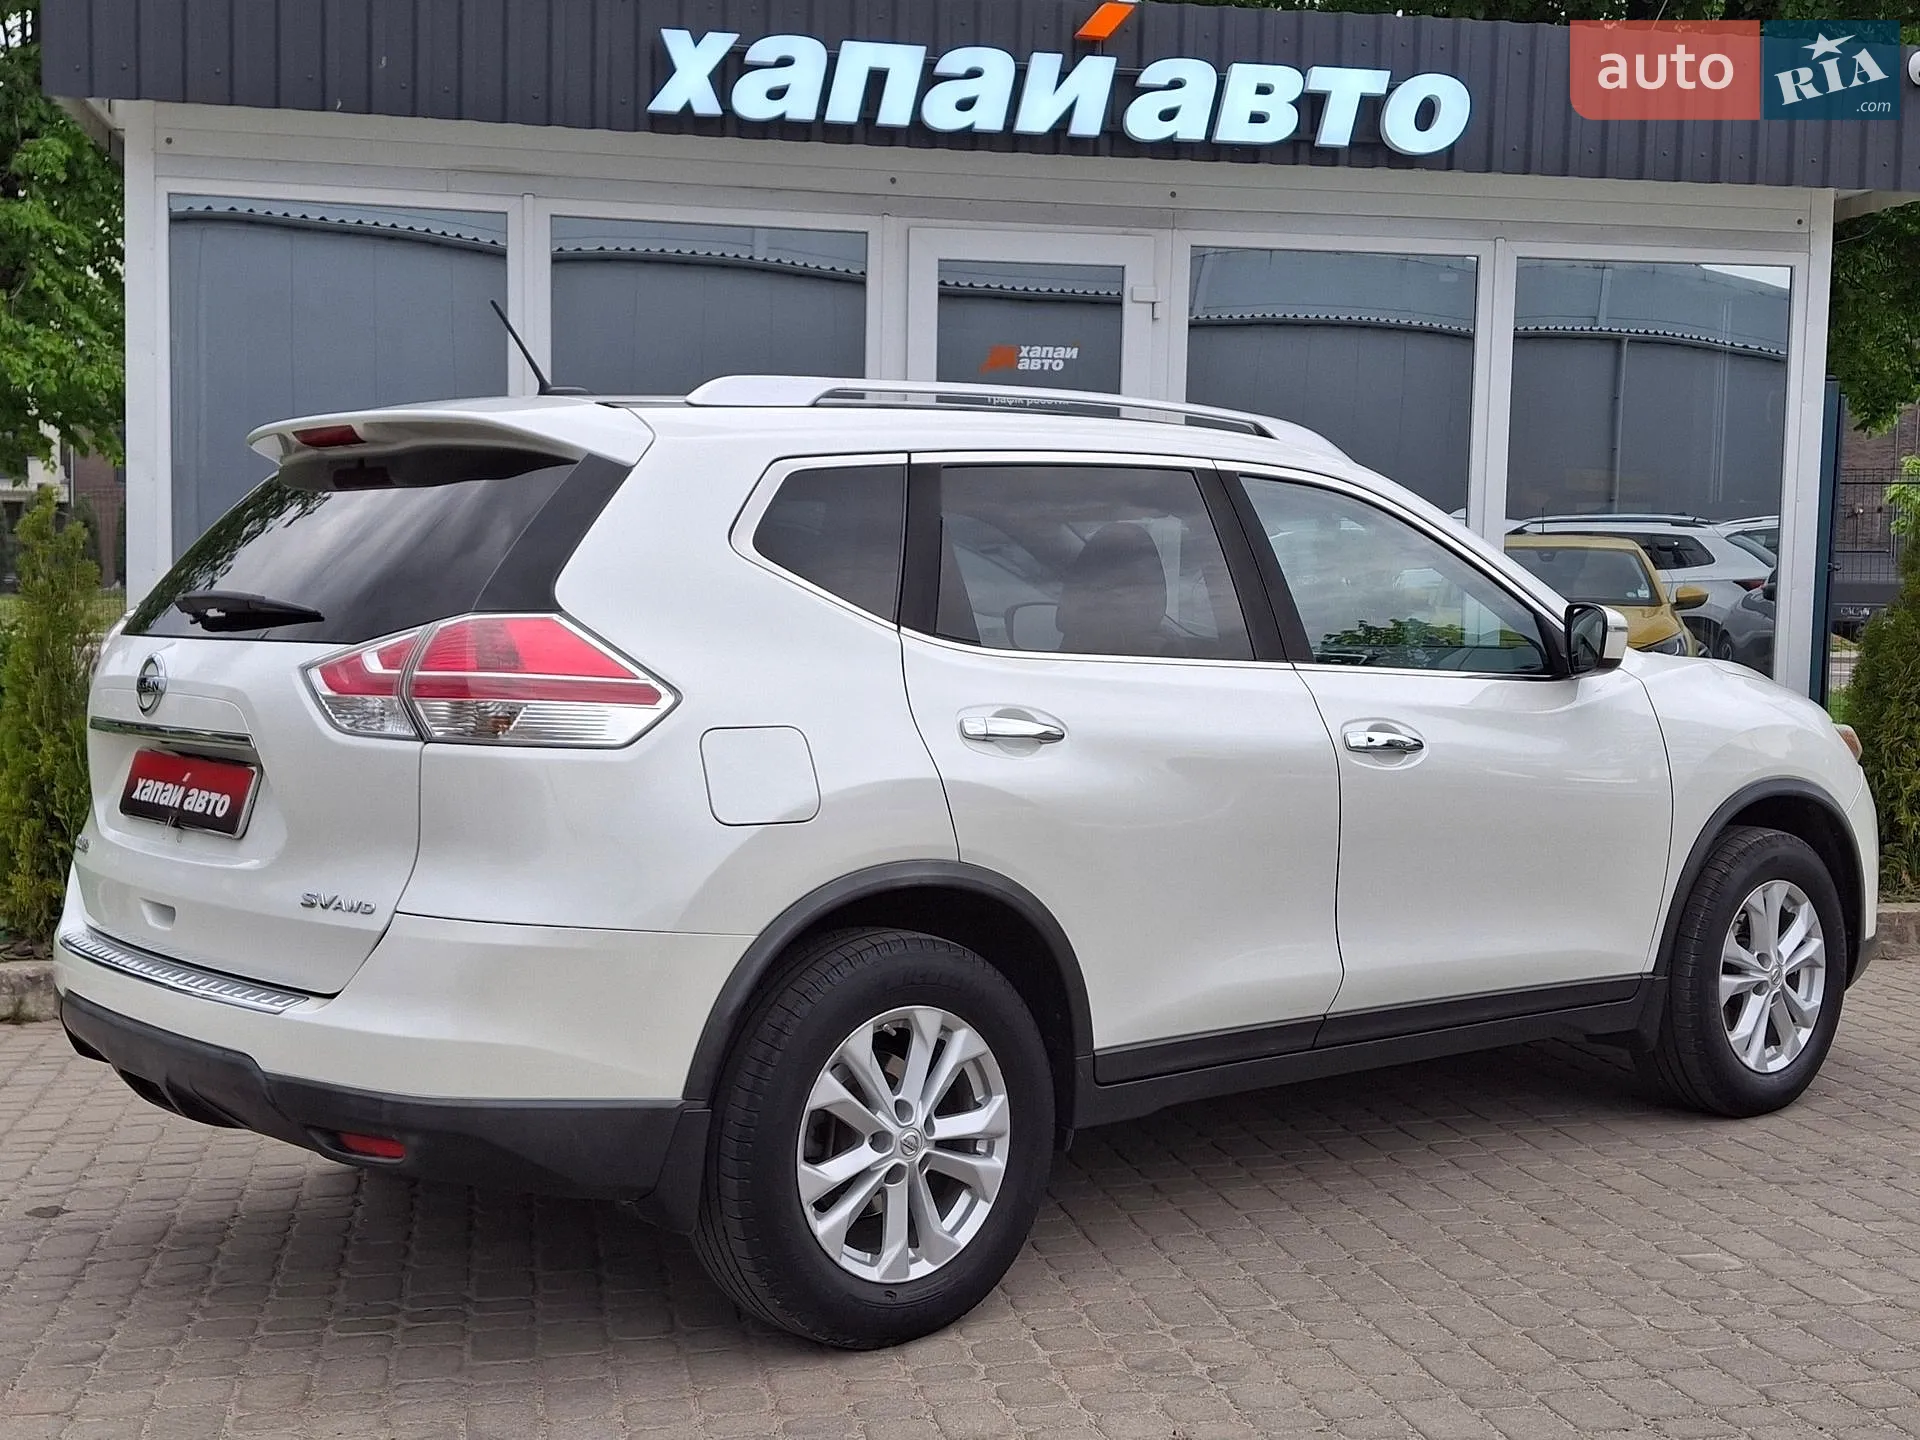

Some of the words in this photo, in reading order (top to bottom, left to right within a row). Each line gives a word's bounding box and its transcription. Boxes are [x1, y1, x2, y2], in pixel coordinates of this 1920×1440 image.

[1122, 56, 1472, 156] авто
[1017, 358, 1064, 371] авто
[183, 788, 231, 818] авто
